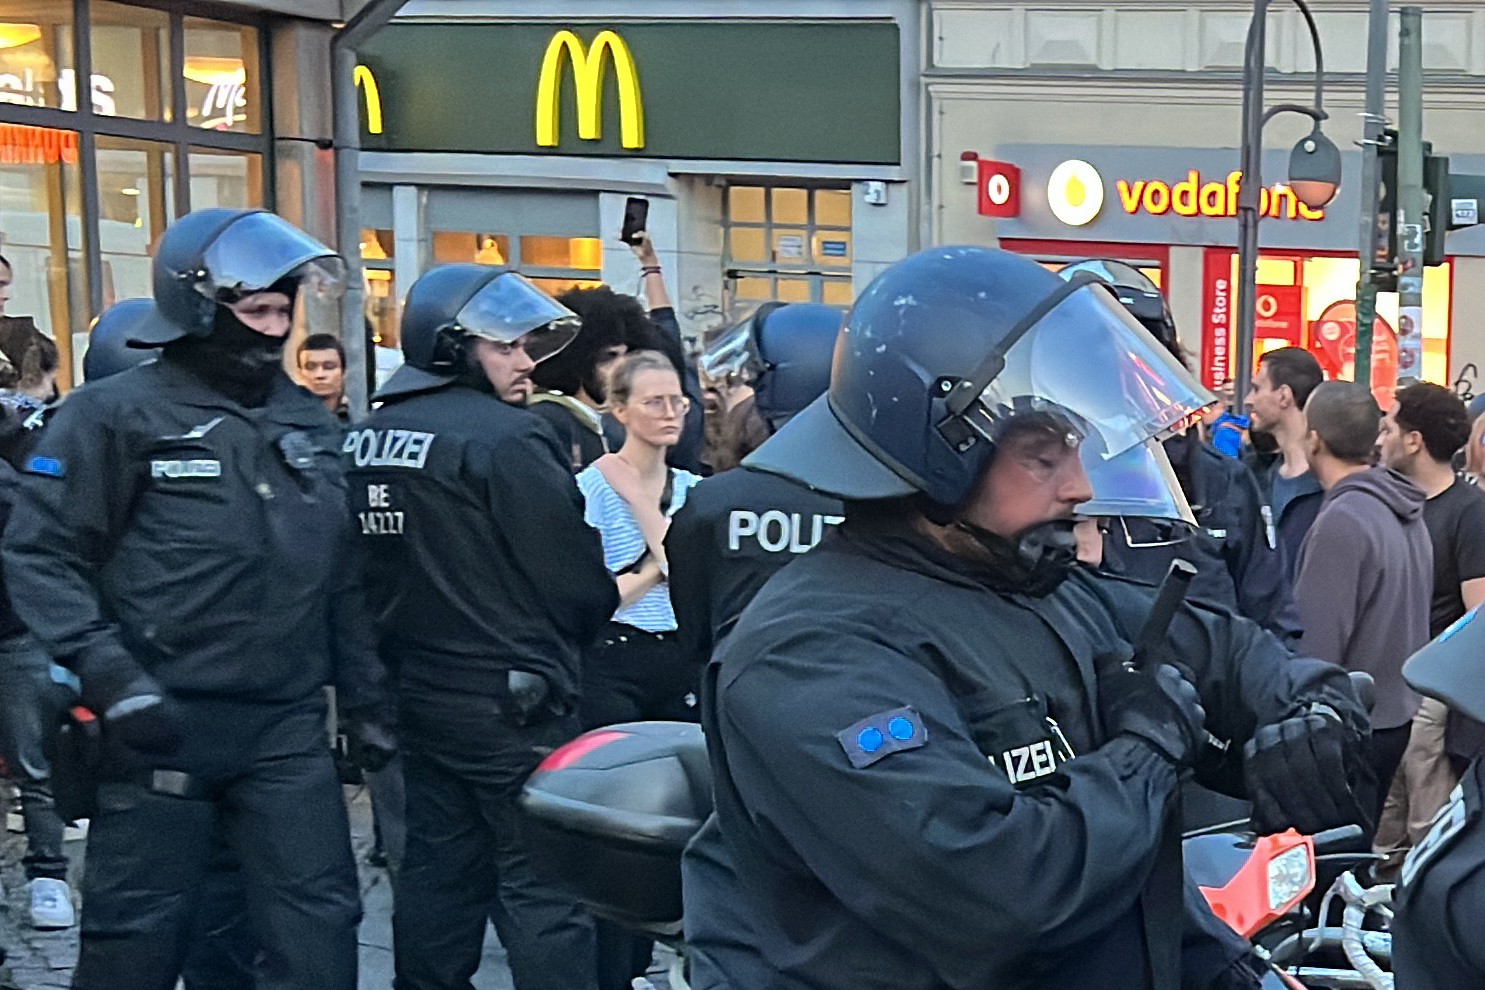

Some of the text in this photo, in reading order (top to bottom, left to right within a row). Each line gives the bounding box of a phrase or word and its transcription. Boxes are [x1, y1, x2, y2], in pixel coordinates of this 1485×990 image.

[1116, 168, 1325, 221] vodafn
[1211, 279, 1227, 325] Store
[342, 428, 436, 469] POLIZEI
[367, 484, 390, 508] BE
[728, 510, 846, 554] POLI
[988, 739, 1056, 785] IZEI
